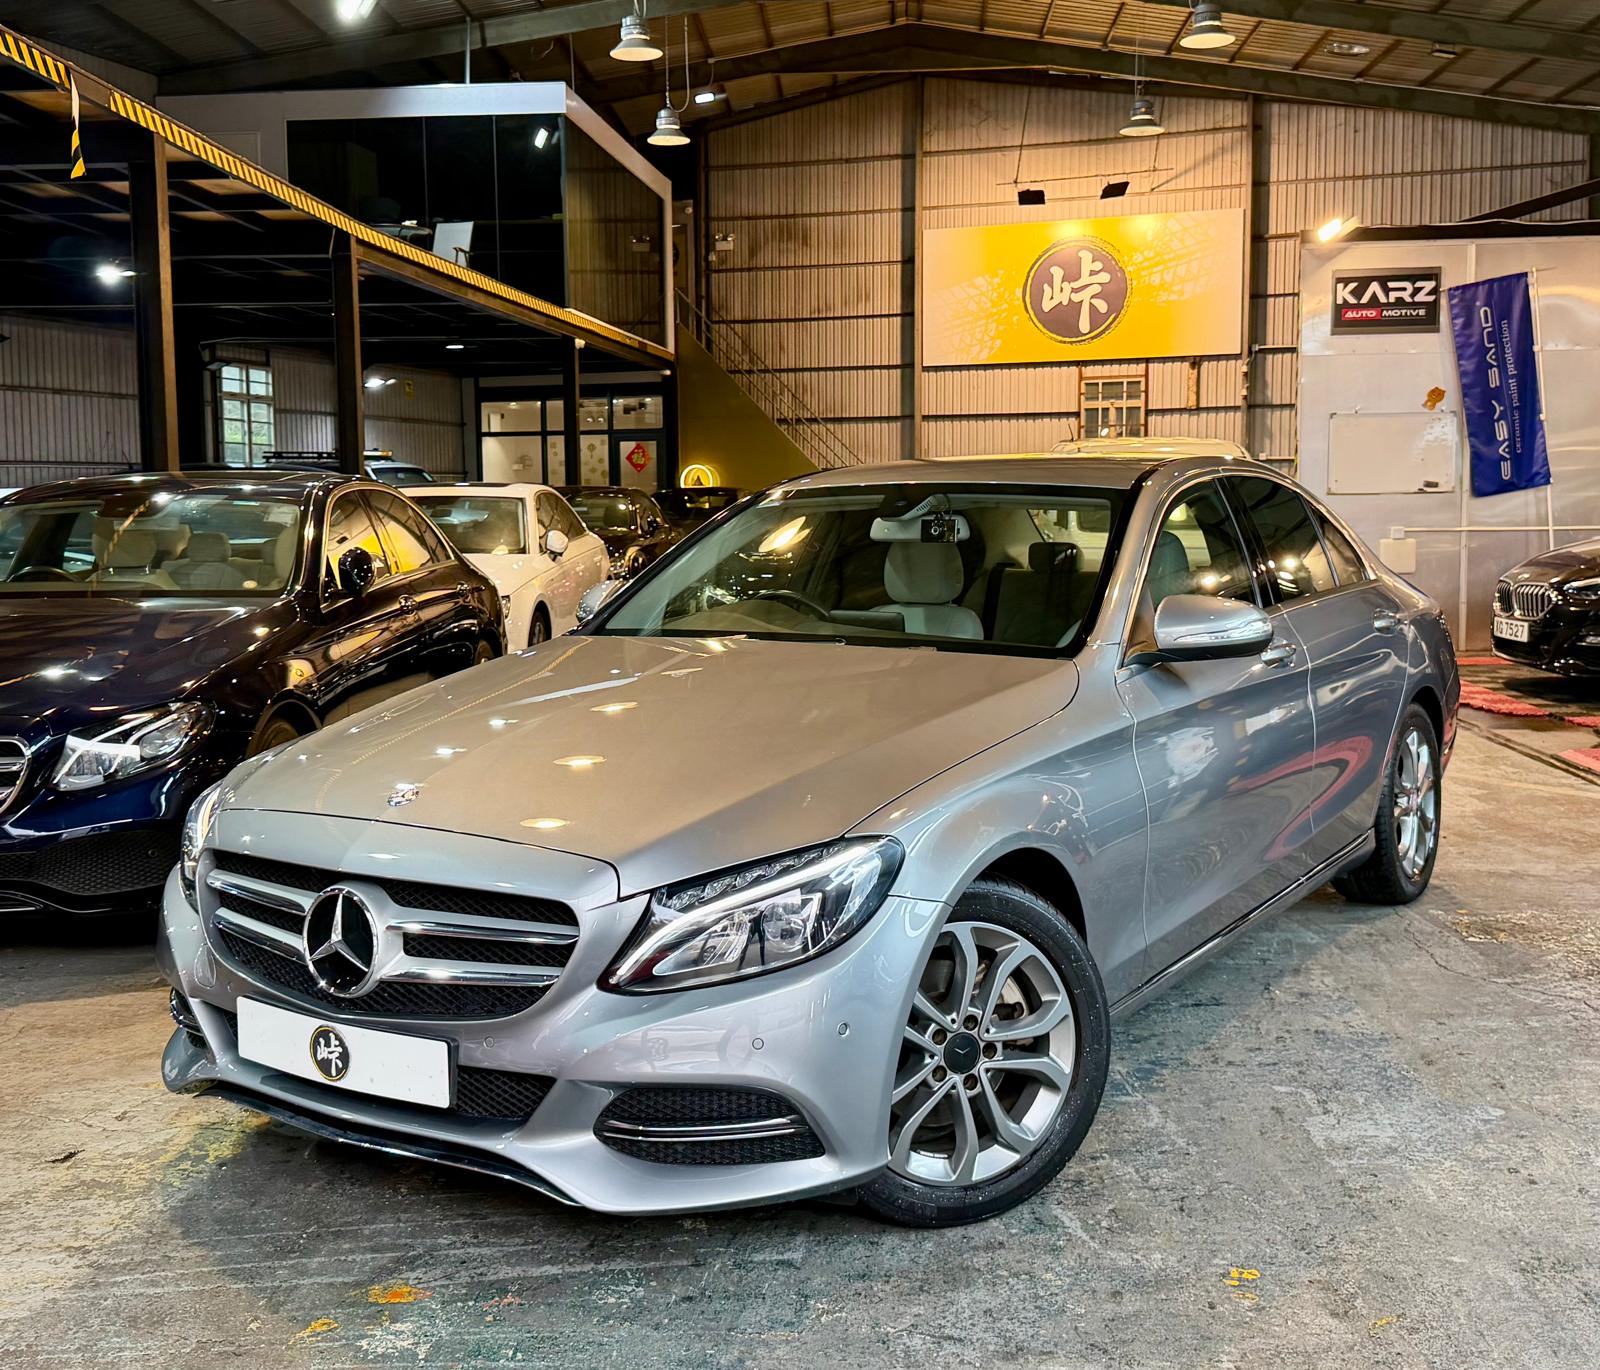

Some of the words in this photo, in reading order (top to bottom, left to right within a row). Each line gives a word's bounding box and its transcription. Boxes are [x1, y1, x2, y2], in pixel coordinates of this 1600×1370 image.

[1042, 249, 1111, 334] 峠
[1336, 281, 1437, 304] KARZ
[1344, 310, 1377, 318] AUTO
[1381, 308, 1426, 317] MOTIVE
[1480, 306, 1500, 388] SAND
[1501, 320, 1518, 375] protection
[1508, 379, 1521, 407] paint
[1491, 400, 1511, 480] EASY
[1512, 410, 1522, 453] ceramic
[1505, 622, 1525, 639] 7527
[317, 1032, 343, 1077] 峠
